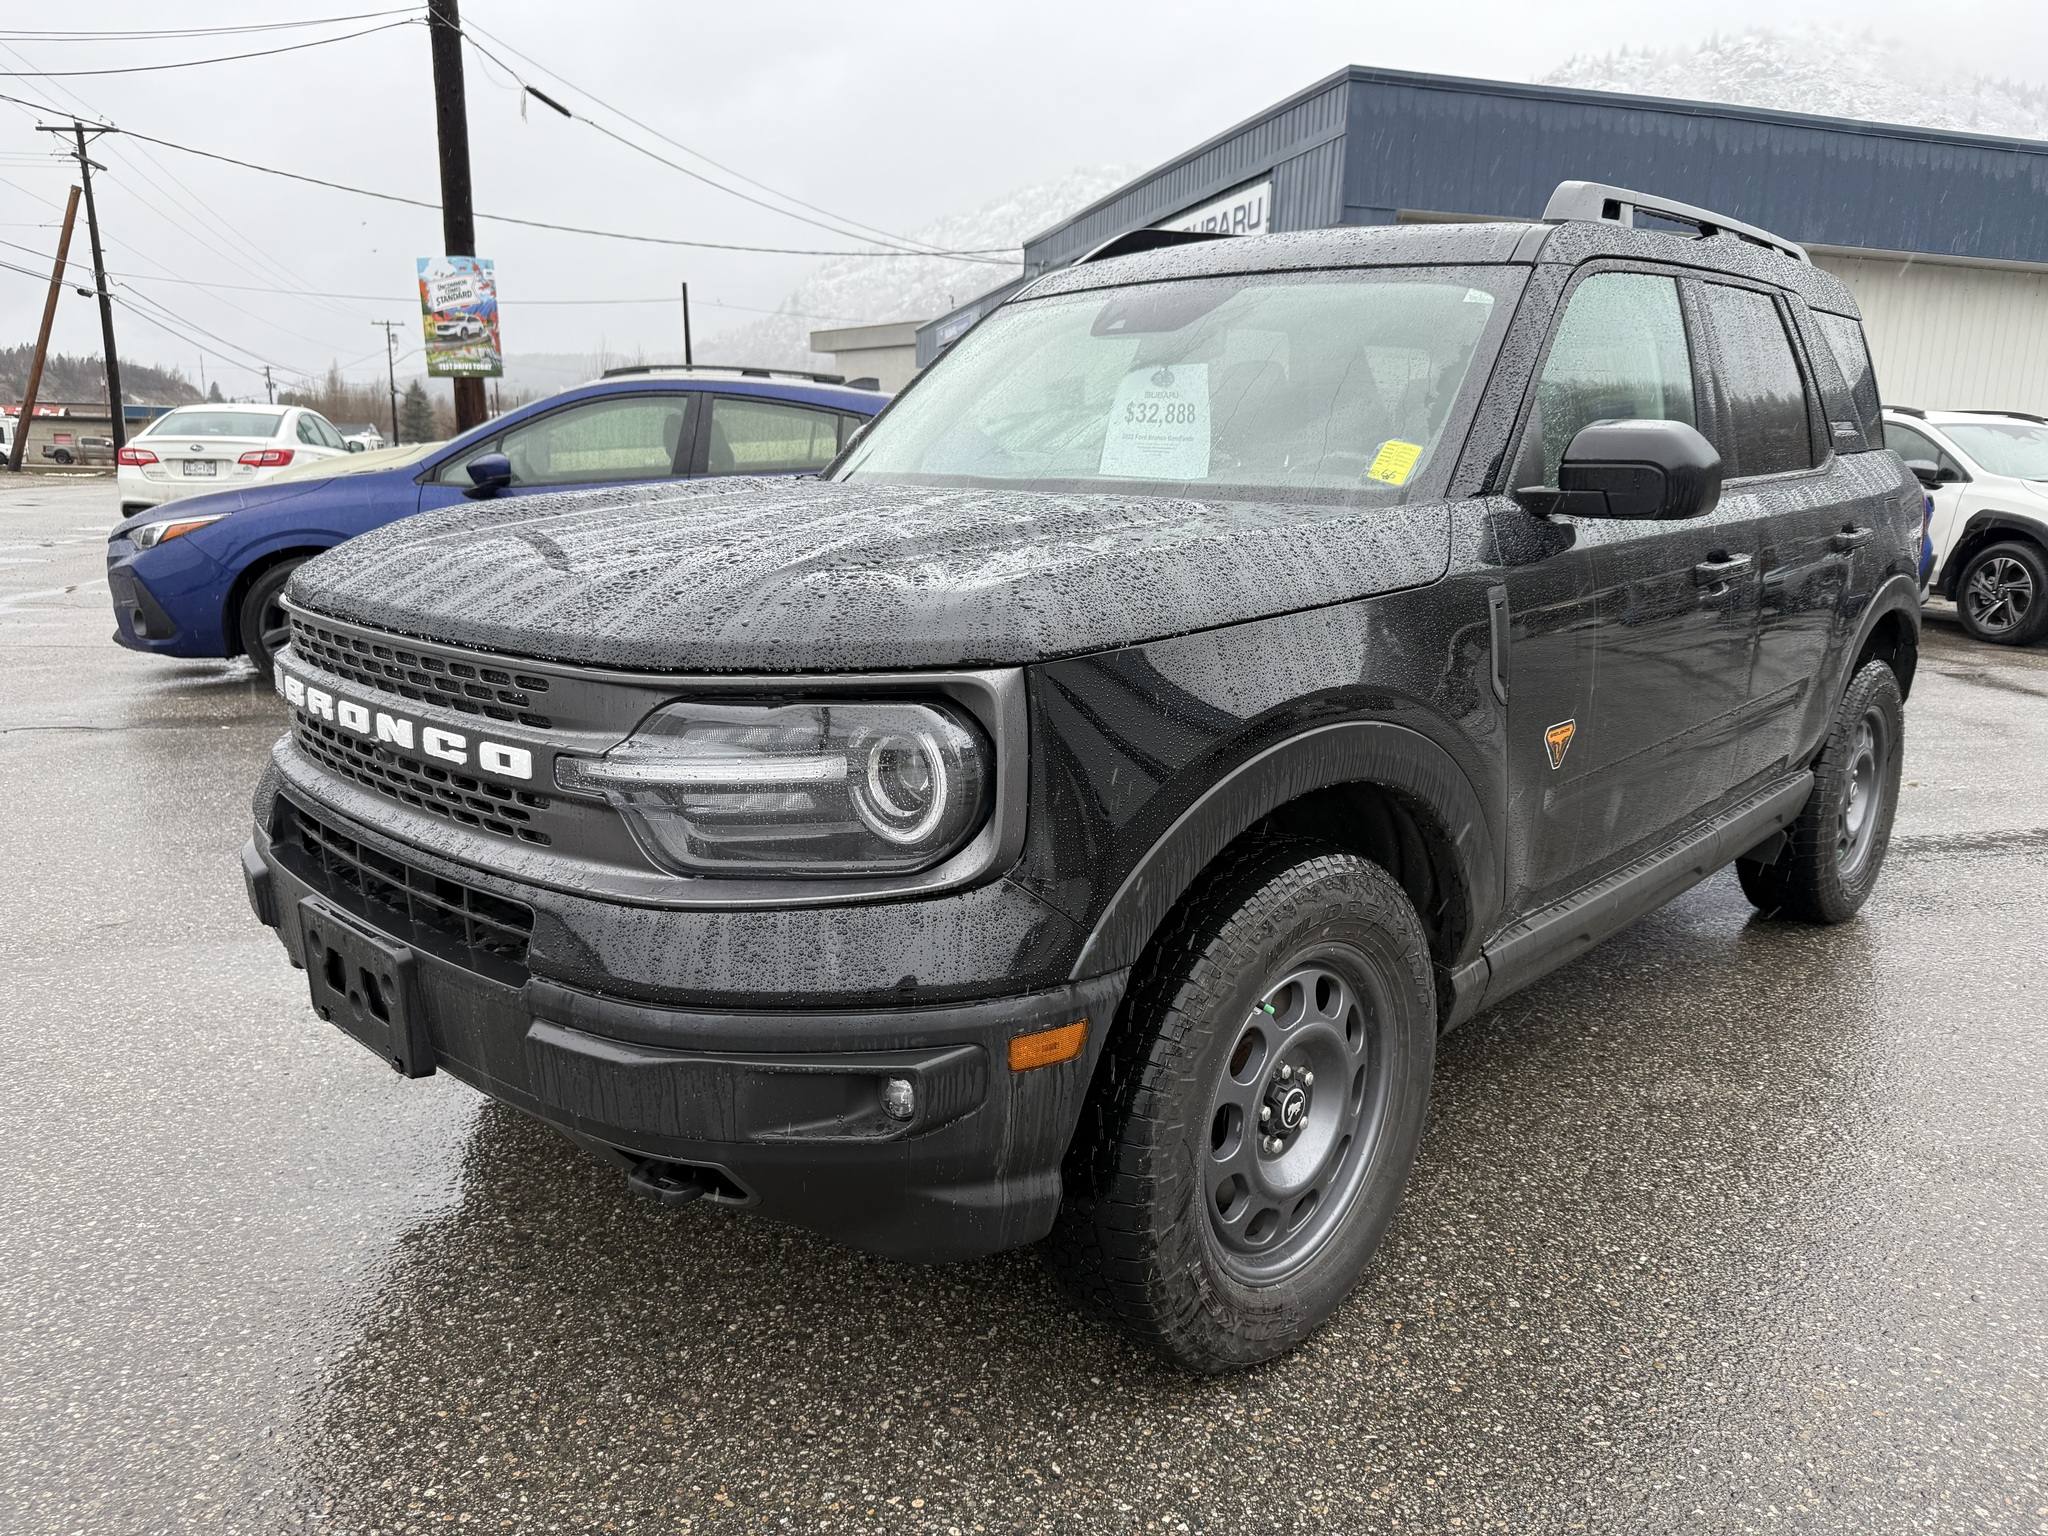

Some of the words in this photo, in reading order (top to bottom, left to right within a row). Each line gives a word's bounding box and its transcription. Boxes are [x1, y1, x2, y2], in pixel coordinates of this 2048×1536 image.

[436, 290, 472, 306] STANDARD
[1125, 401, 1196, 428] $32,888
[284, 675, 533, 780] BRONCO
[1265, 900, 1407, 974] WILDPEAK
